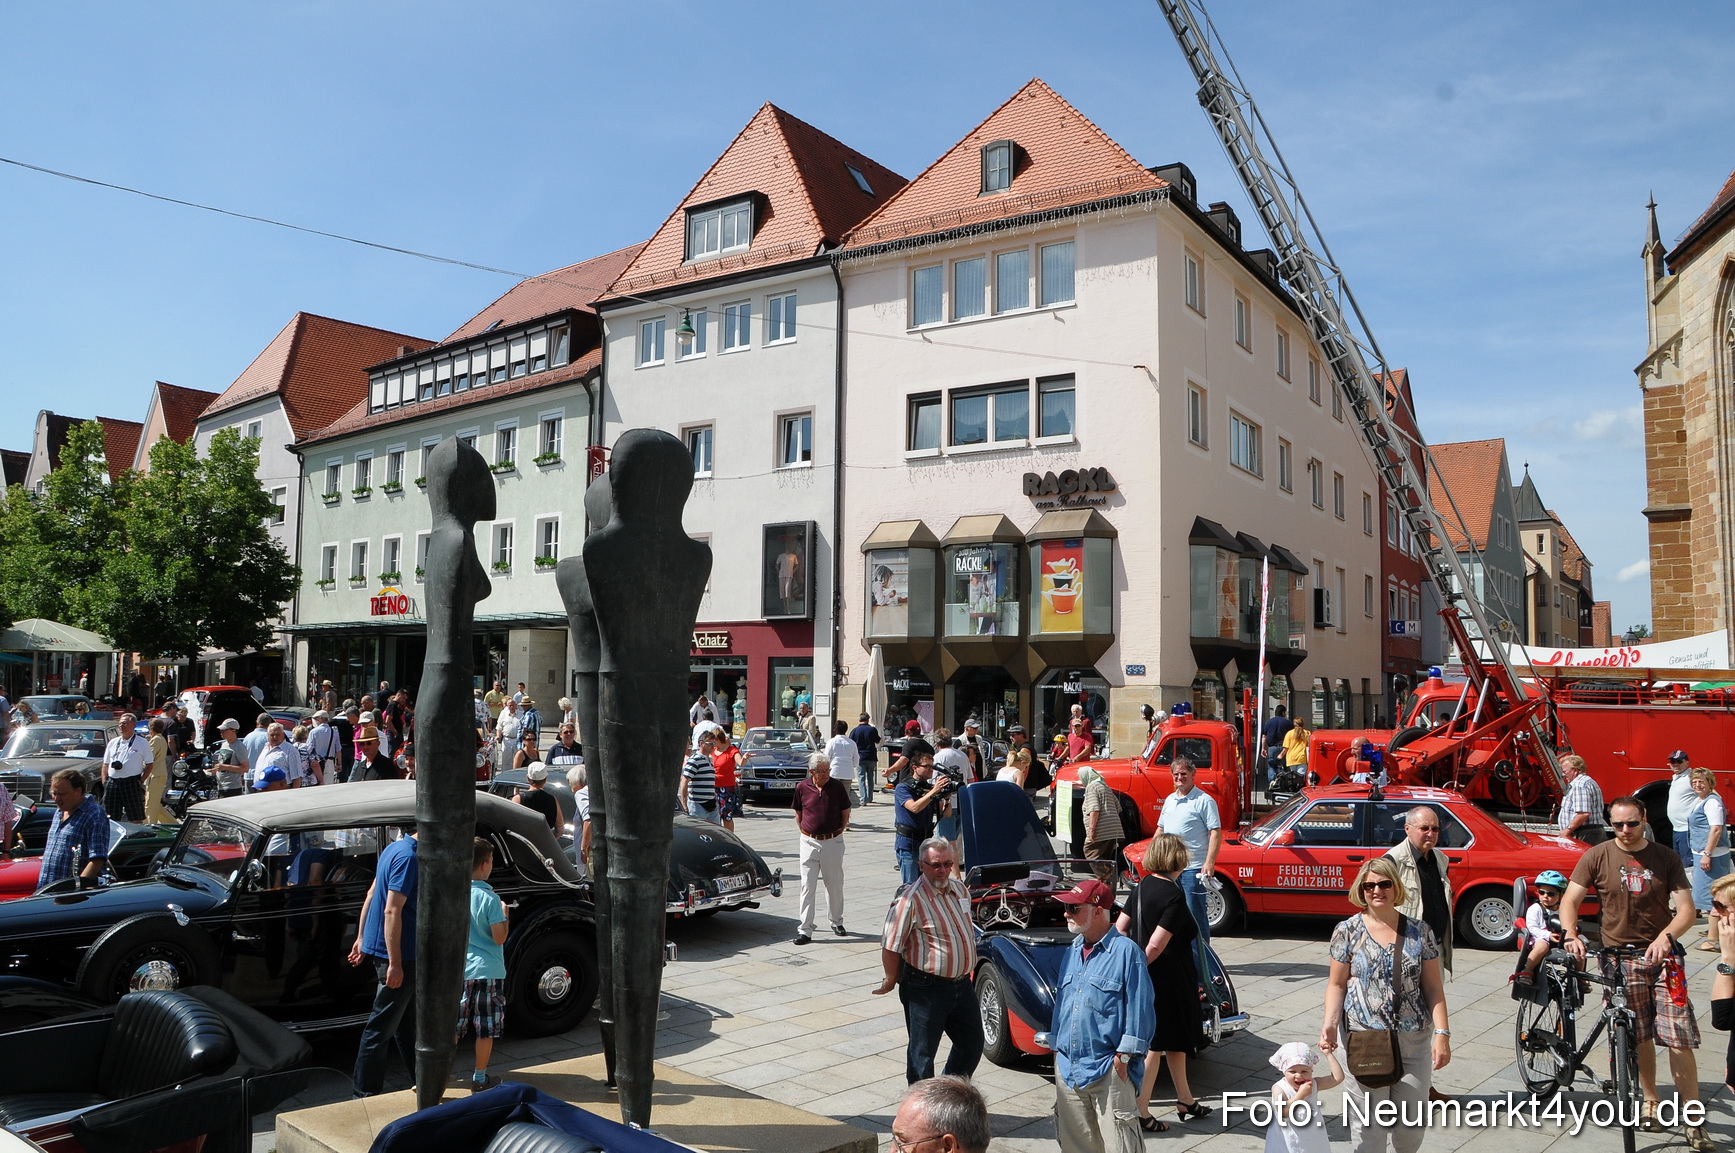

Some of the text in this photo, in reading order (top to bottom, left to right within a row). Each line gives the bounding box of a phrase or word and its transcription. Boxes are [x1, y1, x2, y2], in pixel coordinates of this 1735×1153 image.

[1023, 467, 1116, 496] RACKL
[370, 595, 408, 616] RENO
[1668, 648, 1710, 666] Genuss und
[1238, 867, 1254, 878] ELW
[1279, 865, 1342, 876] FEUERWEHR
[1277, 876, 1344, 887] CADOLZBURG
